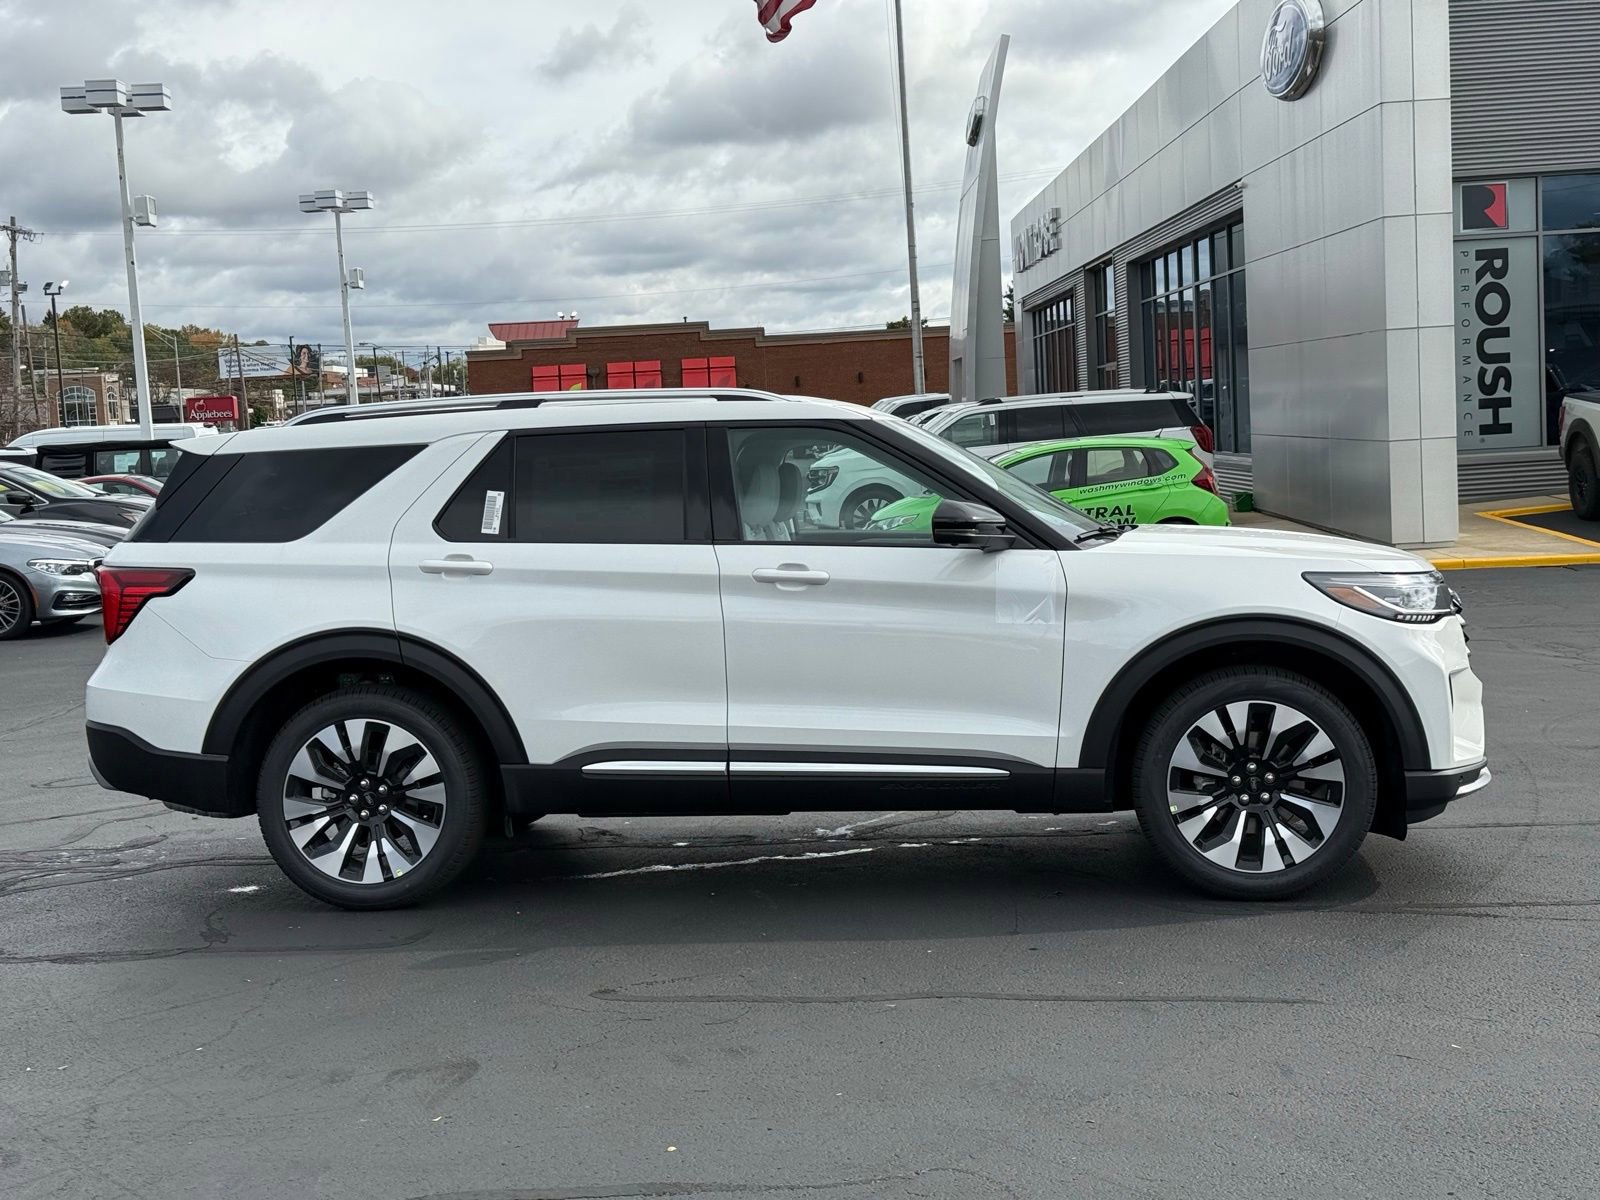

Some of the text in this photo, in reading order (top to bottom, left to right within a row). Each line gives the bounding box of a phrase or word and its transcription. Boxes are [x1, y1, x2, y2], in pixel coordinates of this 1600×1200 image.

[1264, 21, 1294, 81] Ford
[1460, 250, 1473, 437] PERFORMANCE
[1475, 247, 1512, 436] ROUSH
[1080, 504, 1136, 519] TRAL
